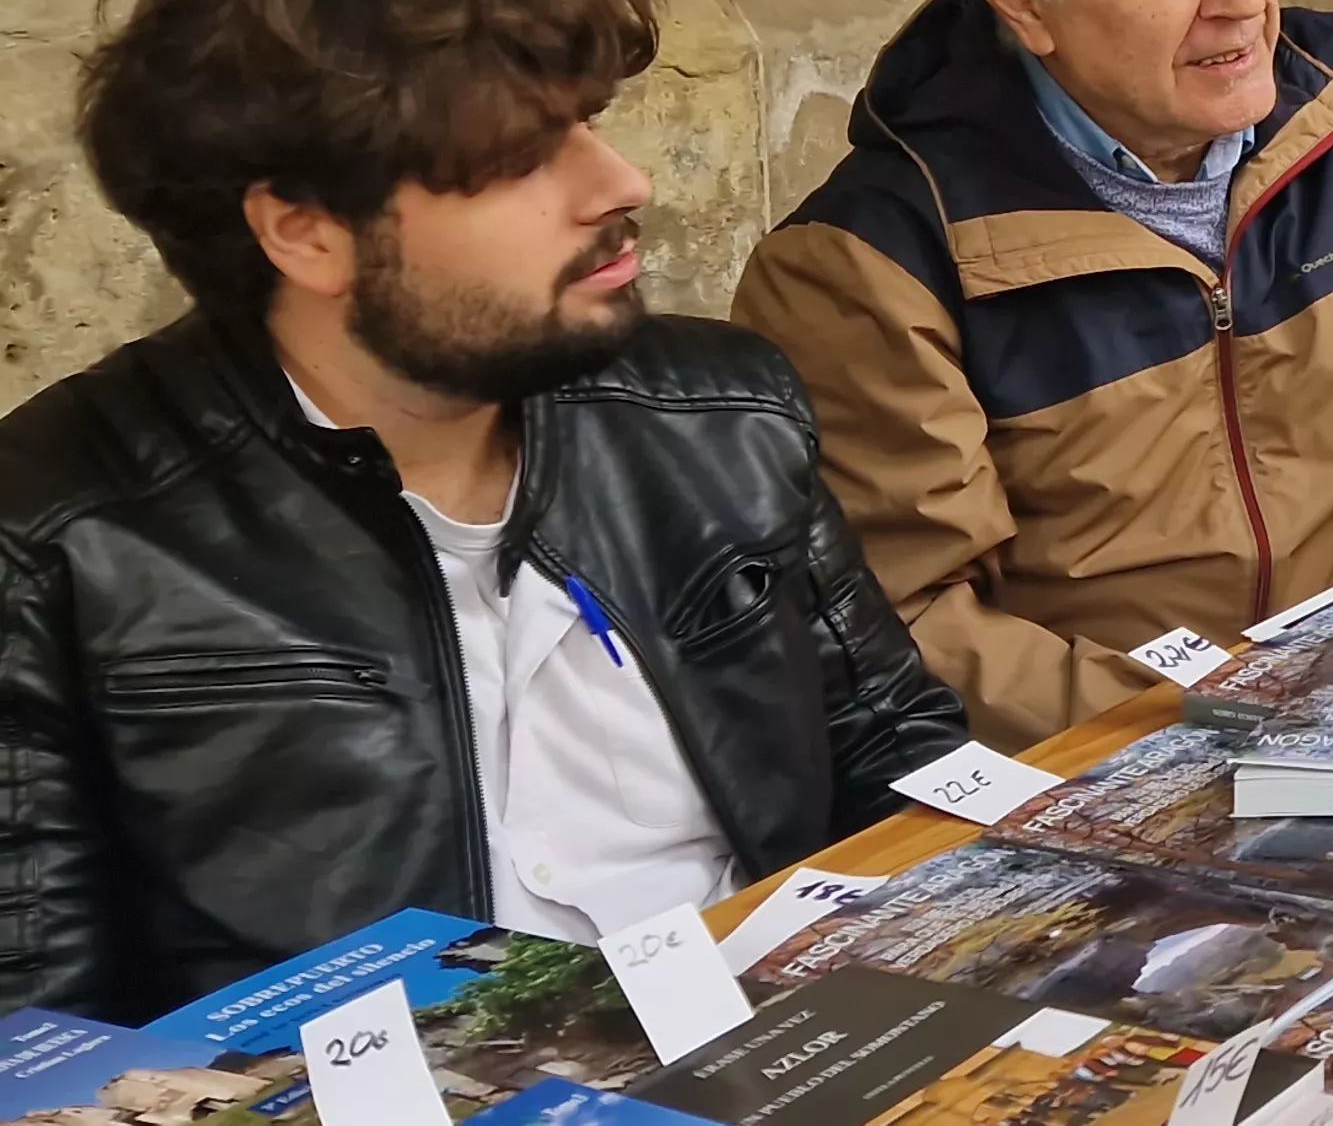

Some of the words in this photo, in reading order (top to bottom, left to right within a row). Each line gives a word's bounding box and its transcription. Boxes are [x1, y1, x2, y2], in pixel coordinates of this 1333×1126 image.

[1022, 763, 1148, 833] FASCINANTE
[617, 930, 686, 968] 20€
[780, 890, 933, 978] FASCINANTE
[205, 943, 385, 1022] SOBREPUERTO
[205, 1018, 259, 1042] Los
[259, 992, 314, 1018] ecos
[312, 975, 355, 994] del
[350, 938, 437, 977] silencio
[760, 1029, 850, 1081] AZLOR
[1179, 1037, 1260, 1109] 15€
[757, 1075, 826, 1116] PUEBLO
